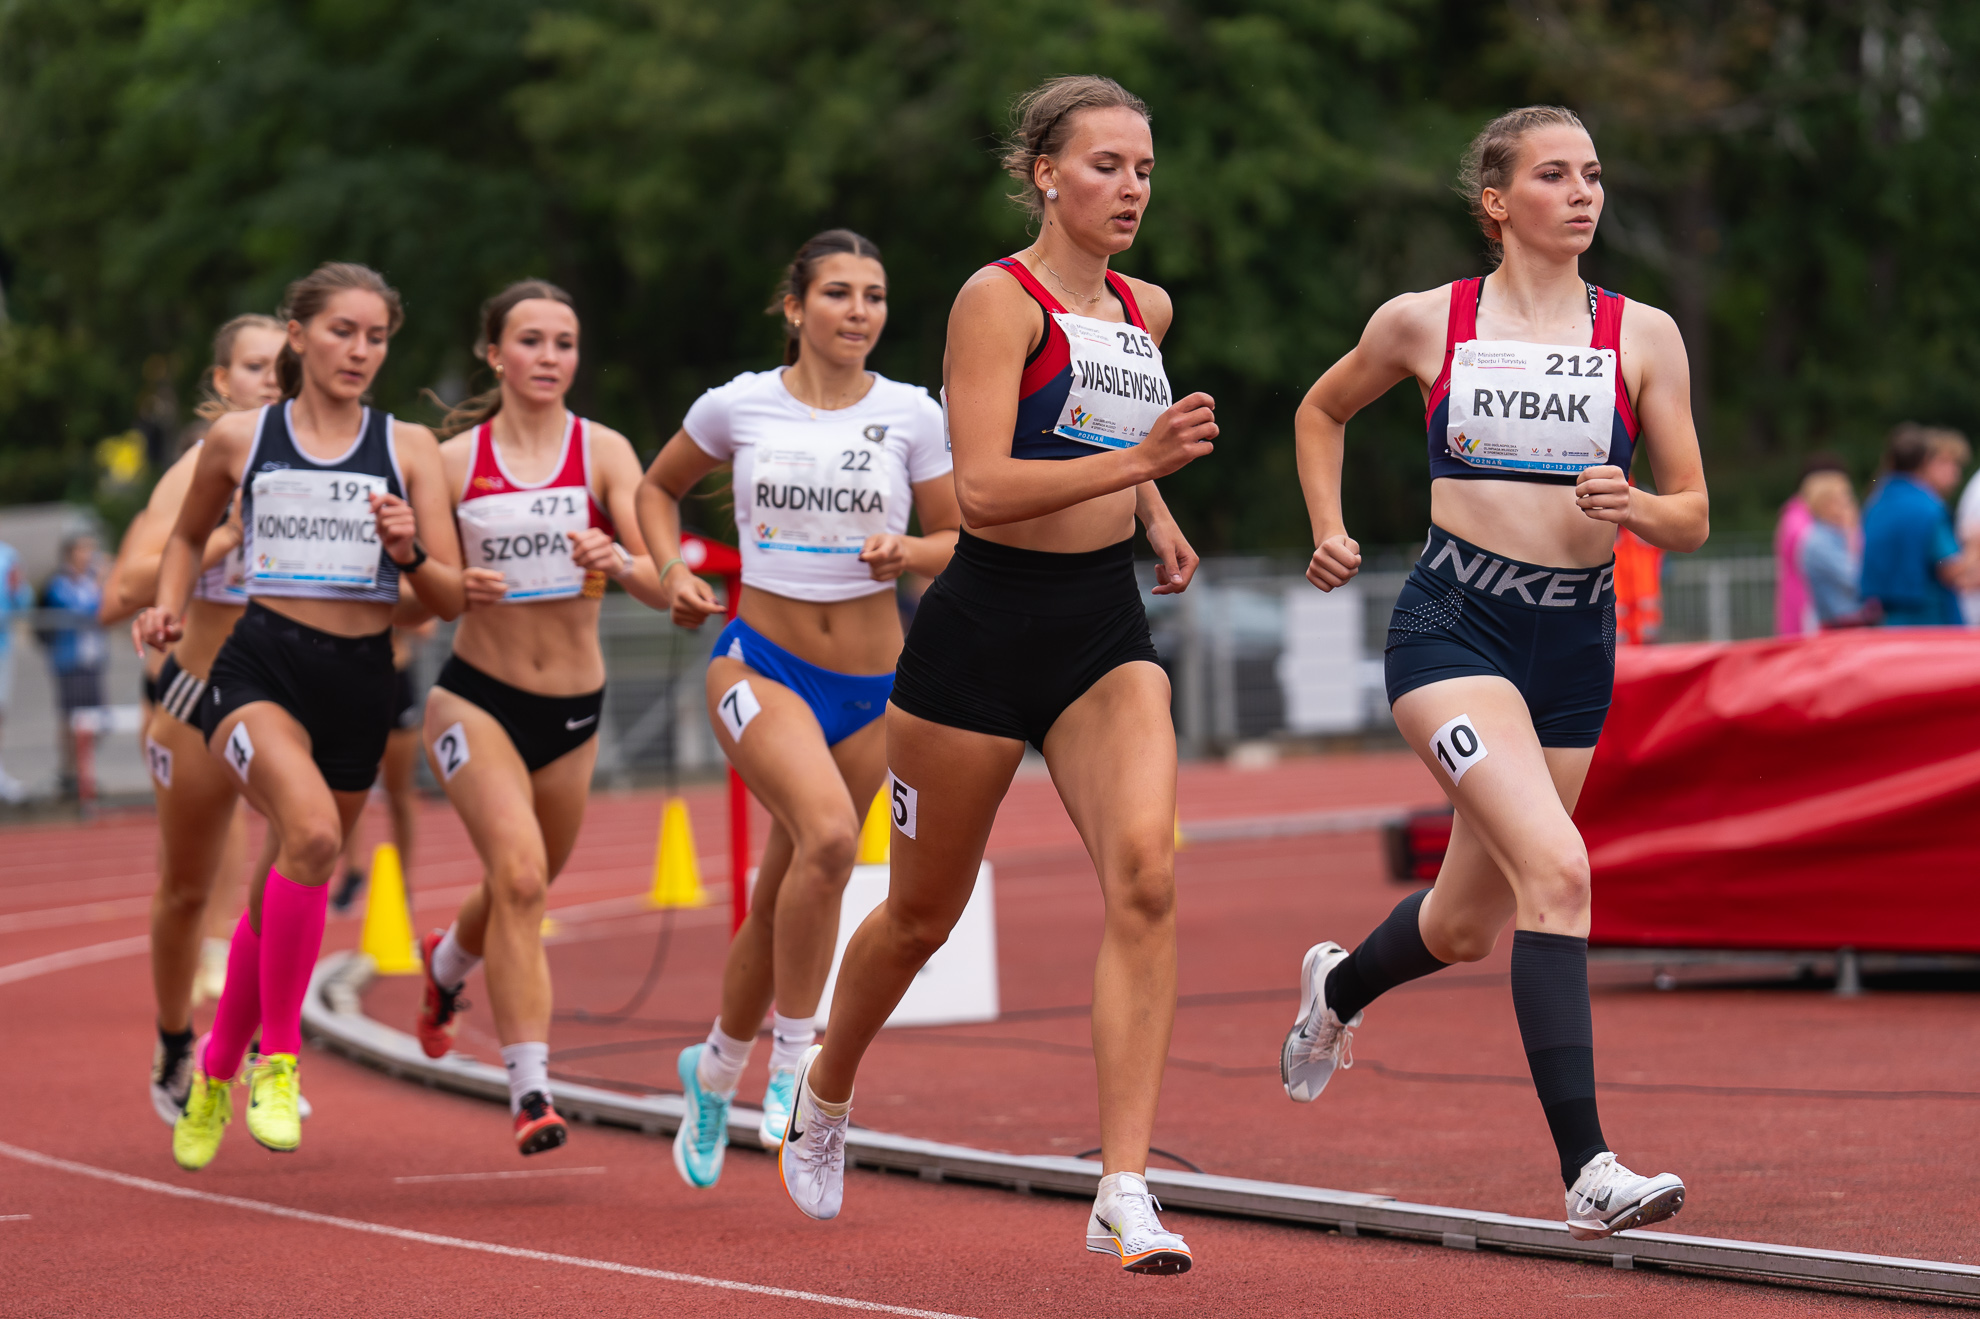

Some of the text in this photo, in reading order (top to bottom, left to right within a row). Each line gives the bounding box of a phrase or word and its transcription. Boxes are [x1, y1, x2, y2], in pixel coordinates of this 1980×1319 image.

[1116, 331, 1153, 358] 215
[1545, 353, 1603, 378] 212
[1077, 360, 1169, 407] WASILEWSKA
[1473, 388, 1591, 424] RYBAK
[841, 450, 871, 471] 22
[1471, 458, 1503, 466] POZNAŃ
[329, 481, 373, 502] 191
[530, 496, 576, 516] 471
[756, 483, 883, 513] RUDNICKA
[257, 514, 378, 545] KONDRATOWICZ
[481, 532, 569, 562] SZOPA
[1428, 538, 1590, 607] NIKE
[723, 689, 743, 727] 7
[233, 735, 247, 770] 4
[441, 733, 461, 773] 2
[1436, 724, 1479, 773] 10
[892, 778, 908, 827] 5
